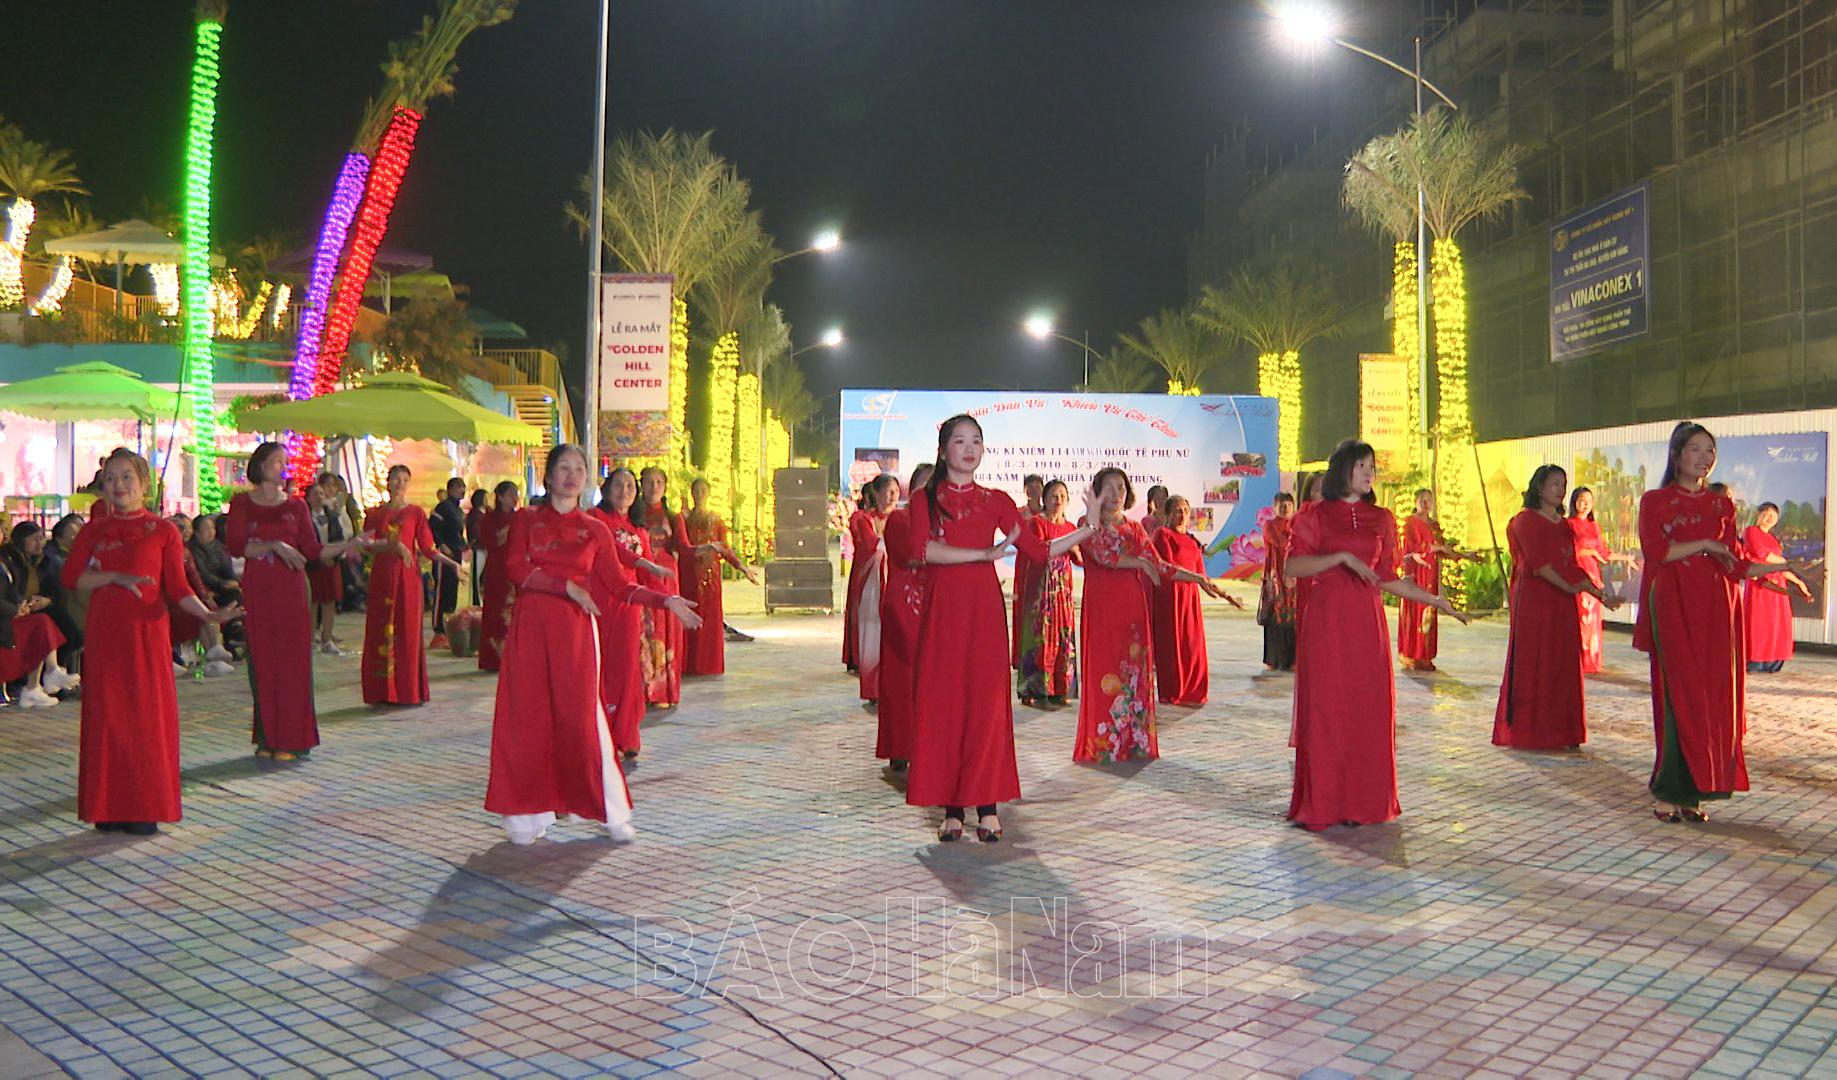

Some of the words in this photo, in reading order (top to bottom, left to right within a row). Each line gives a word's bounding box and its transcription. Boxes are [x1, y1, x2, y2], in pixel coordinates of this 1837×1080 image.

[1569, 272, 1633, 309] VINACONEX
[1636, 269, 1643, 287] 1
[611, 321, 622, 334] LỄ
[625, 325, 638, 334] RA
[612, 345, 664, 354] GOLDEN
[625, 361, 652, 370] HILL
[614, 379, 662, 388] CENTER
[1104, 446, 1132, 456] QUỐC
[1135, 446, 1146, 456] TẾ
[1176, 447, 1190, 458] NỮ
[997, 473, 1019, 482] NĂM
